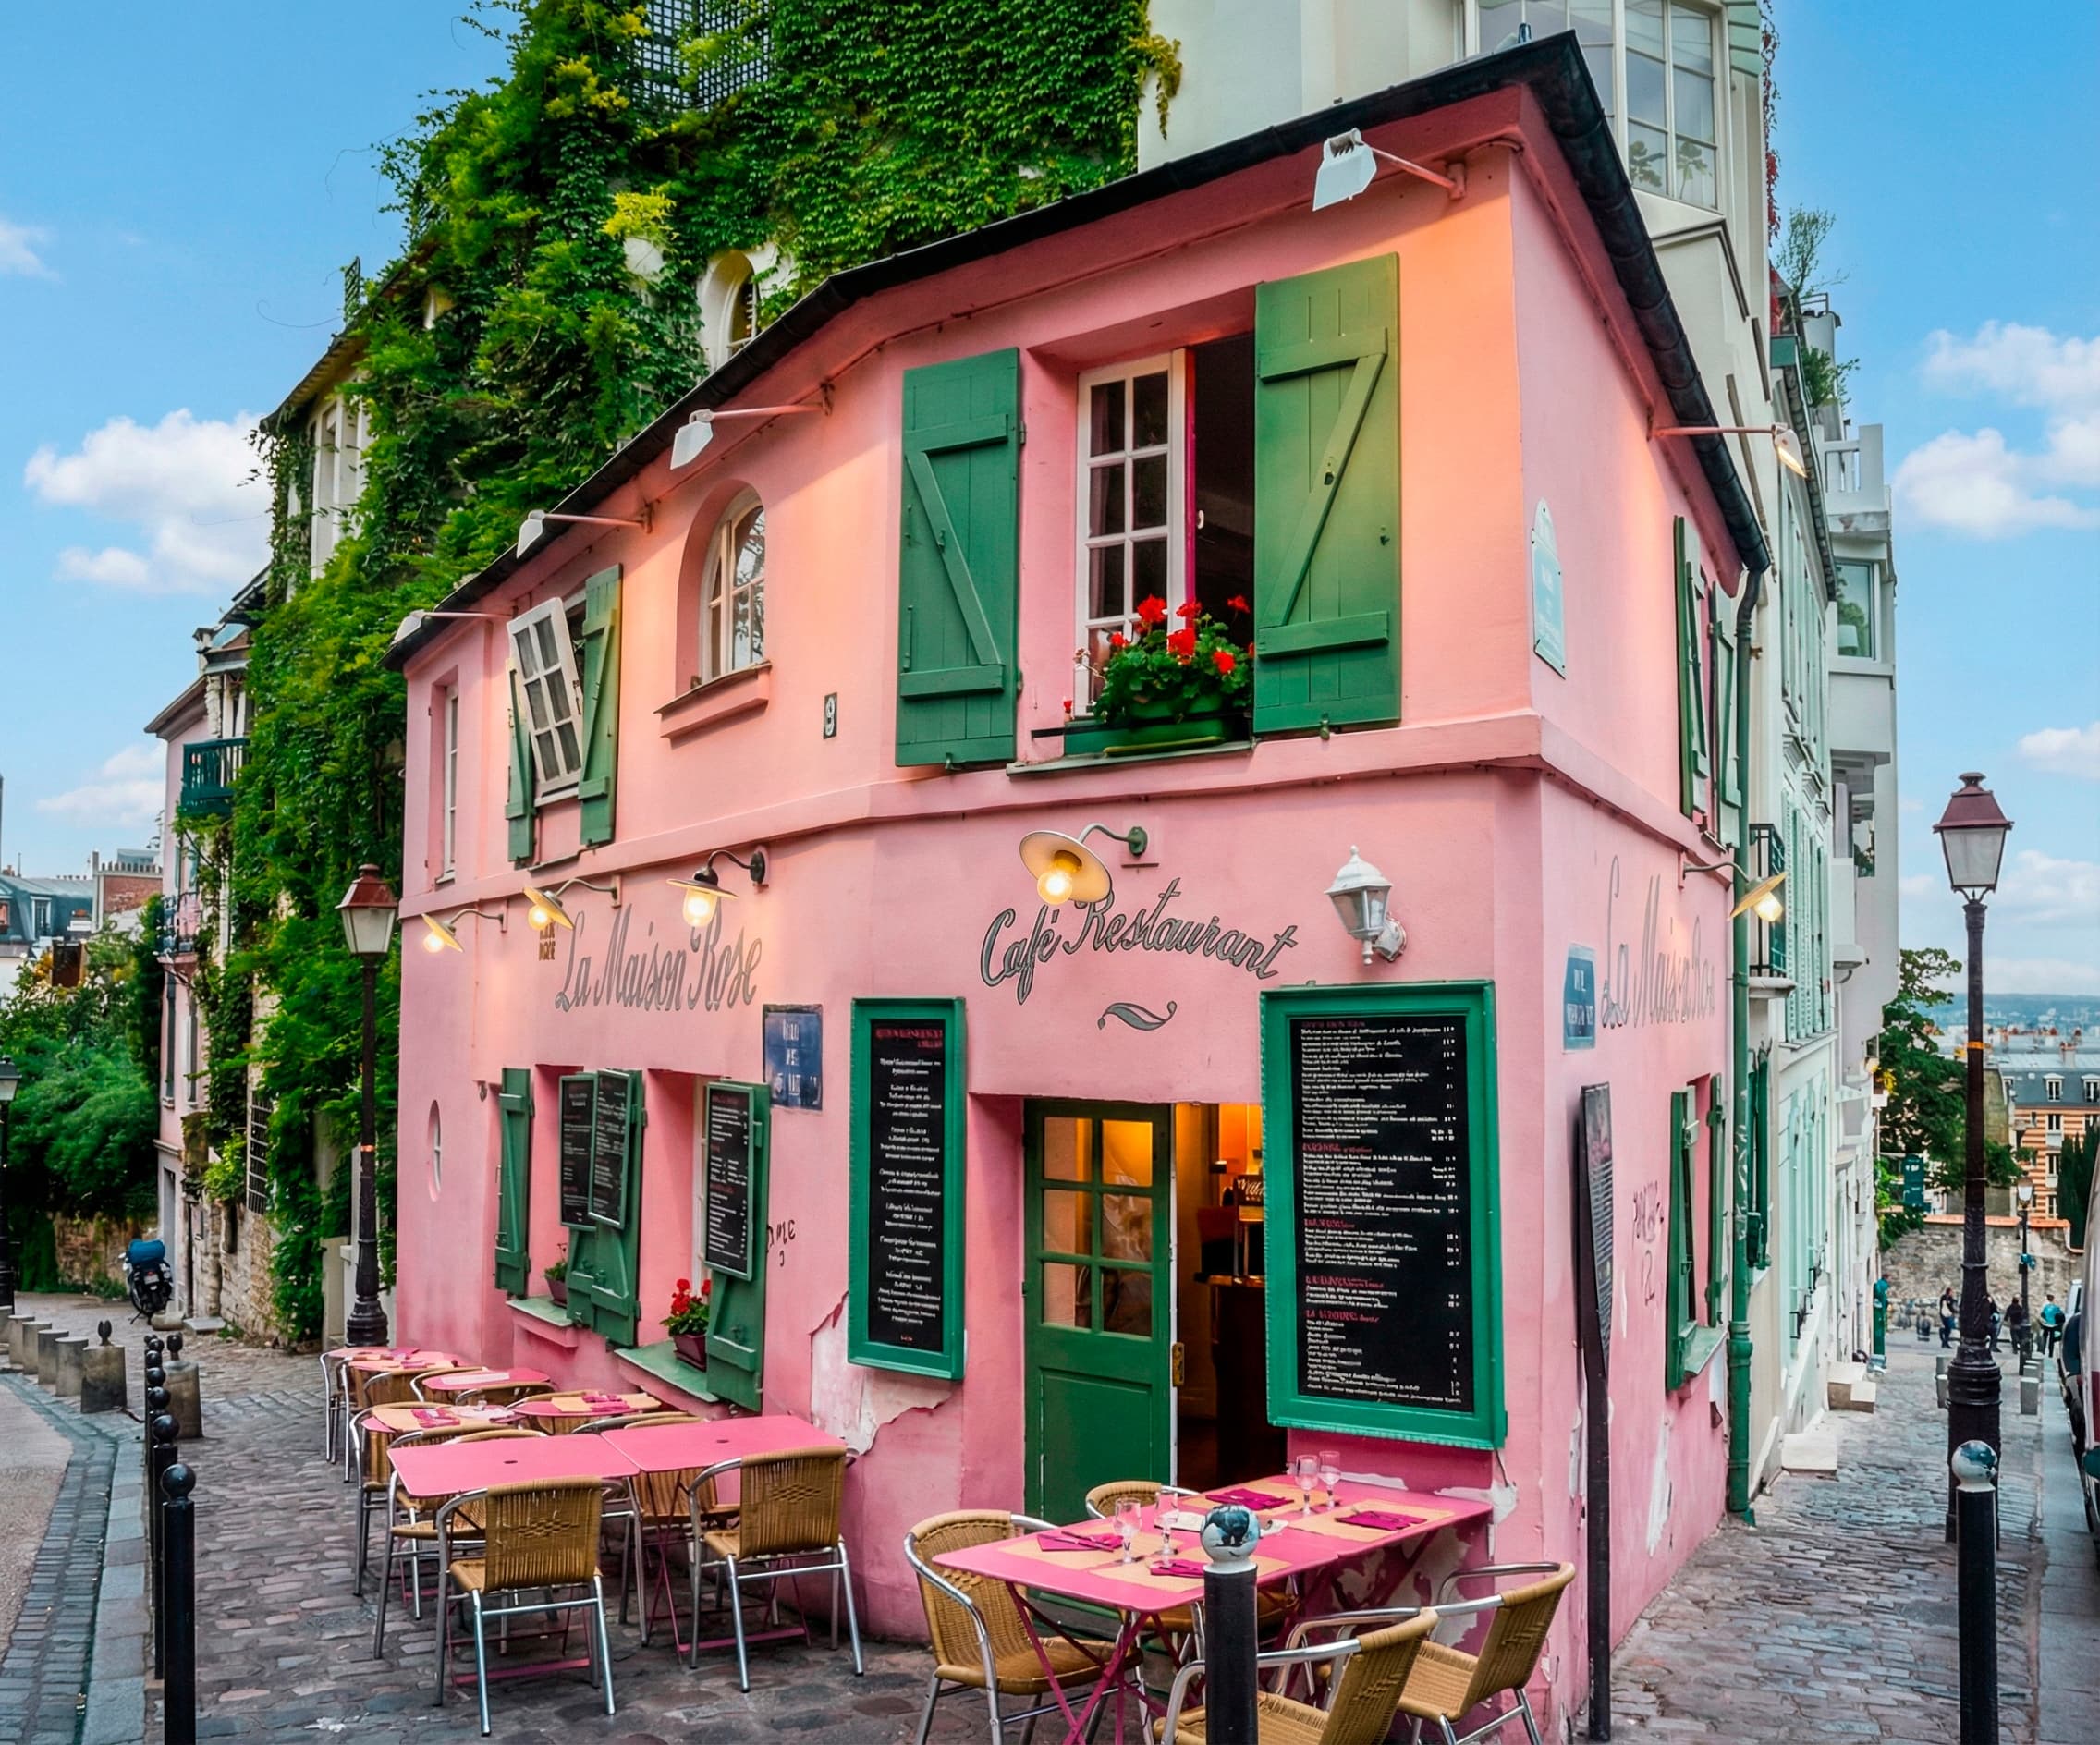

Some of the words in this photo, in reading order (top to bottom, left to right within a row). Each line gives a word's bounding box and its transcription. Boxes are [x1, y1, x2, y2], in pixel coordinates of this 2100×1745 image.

[555, 910, 591, 1012] La
[594, 903, 686, 1012] Maison
[688, 897, 762, 1012] Rose
[980, 905, 1062, 1005] Café
[1063, 877, 1298, 980] Restaurant
